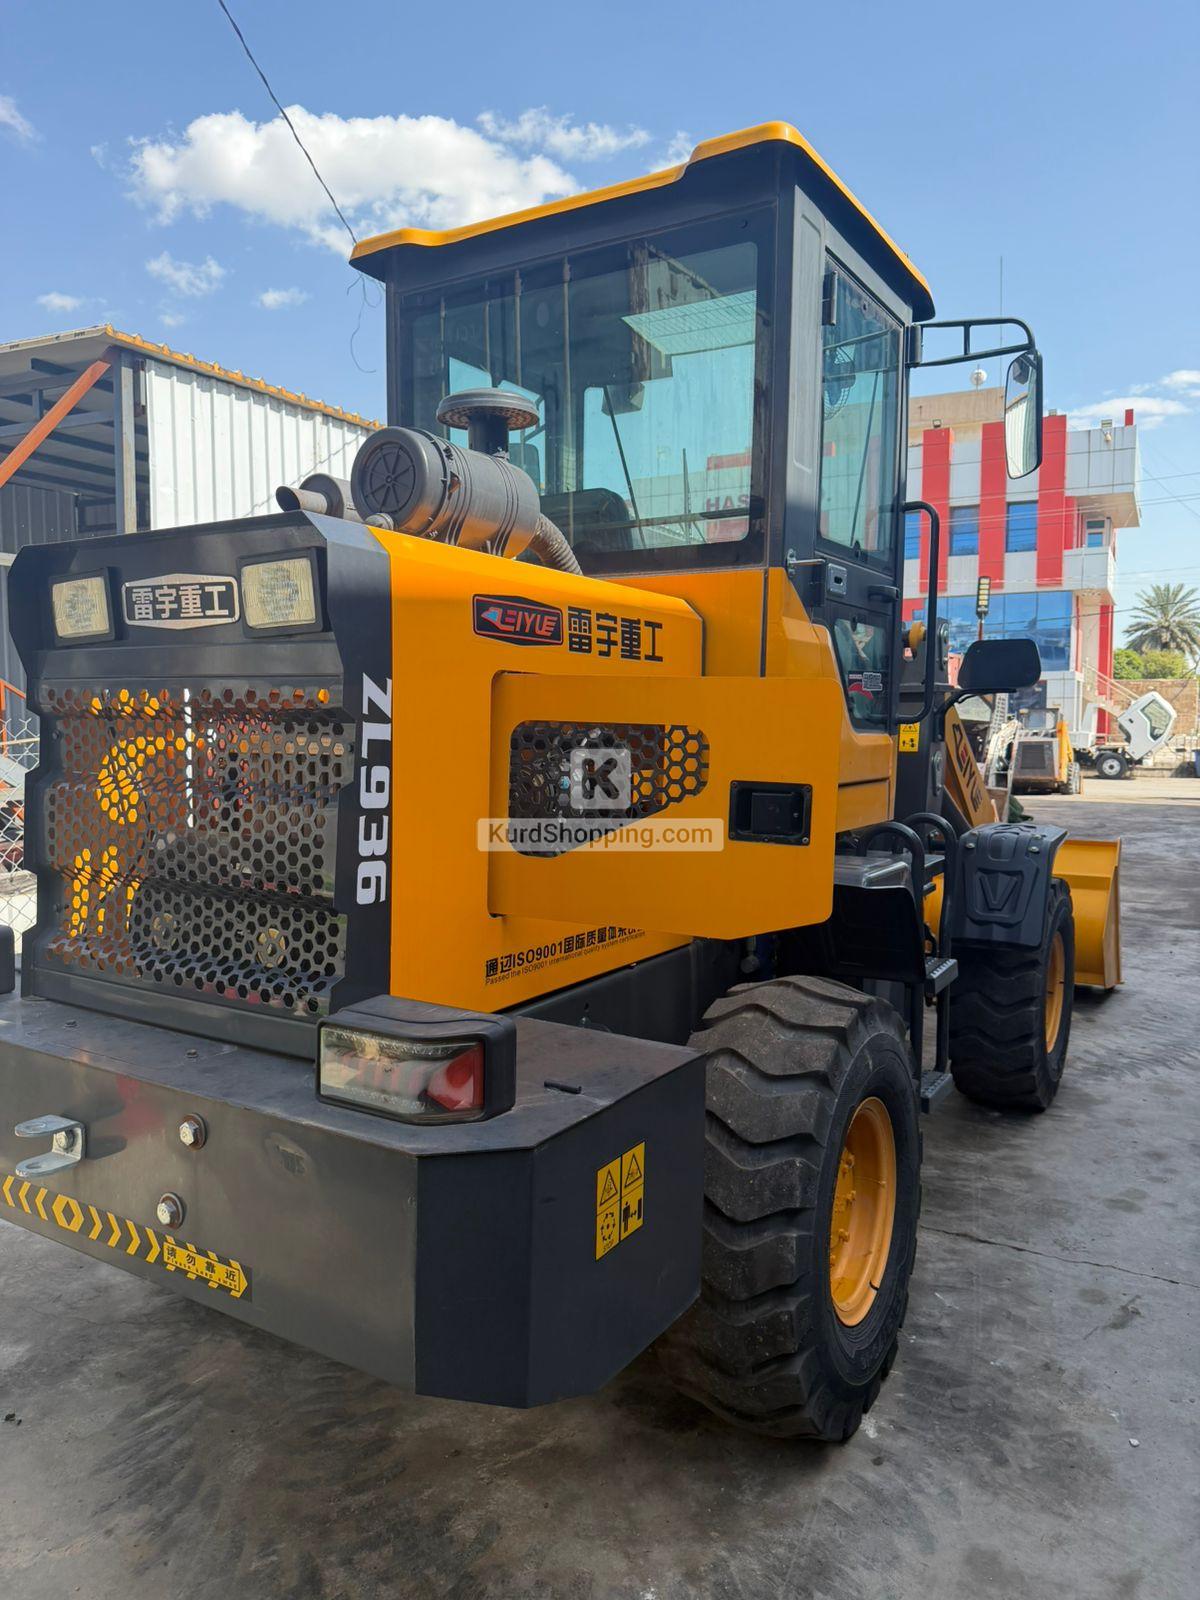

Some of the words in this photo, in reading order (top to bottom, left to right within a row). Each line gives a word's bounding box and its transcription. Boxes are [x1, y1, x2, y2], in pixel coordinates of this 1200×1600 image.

[132, 584, 229, 619] 雷宇重工
[481, 606, 559, 637] LEIYUE
[567, 605, 663, 662] 雷宇重工
[356, 672, 392, 905] ZL936
[486, 926, 642, 977] 通过ISO9001国际质量体系
